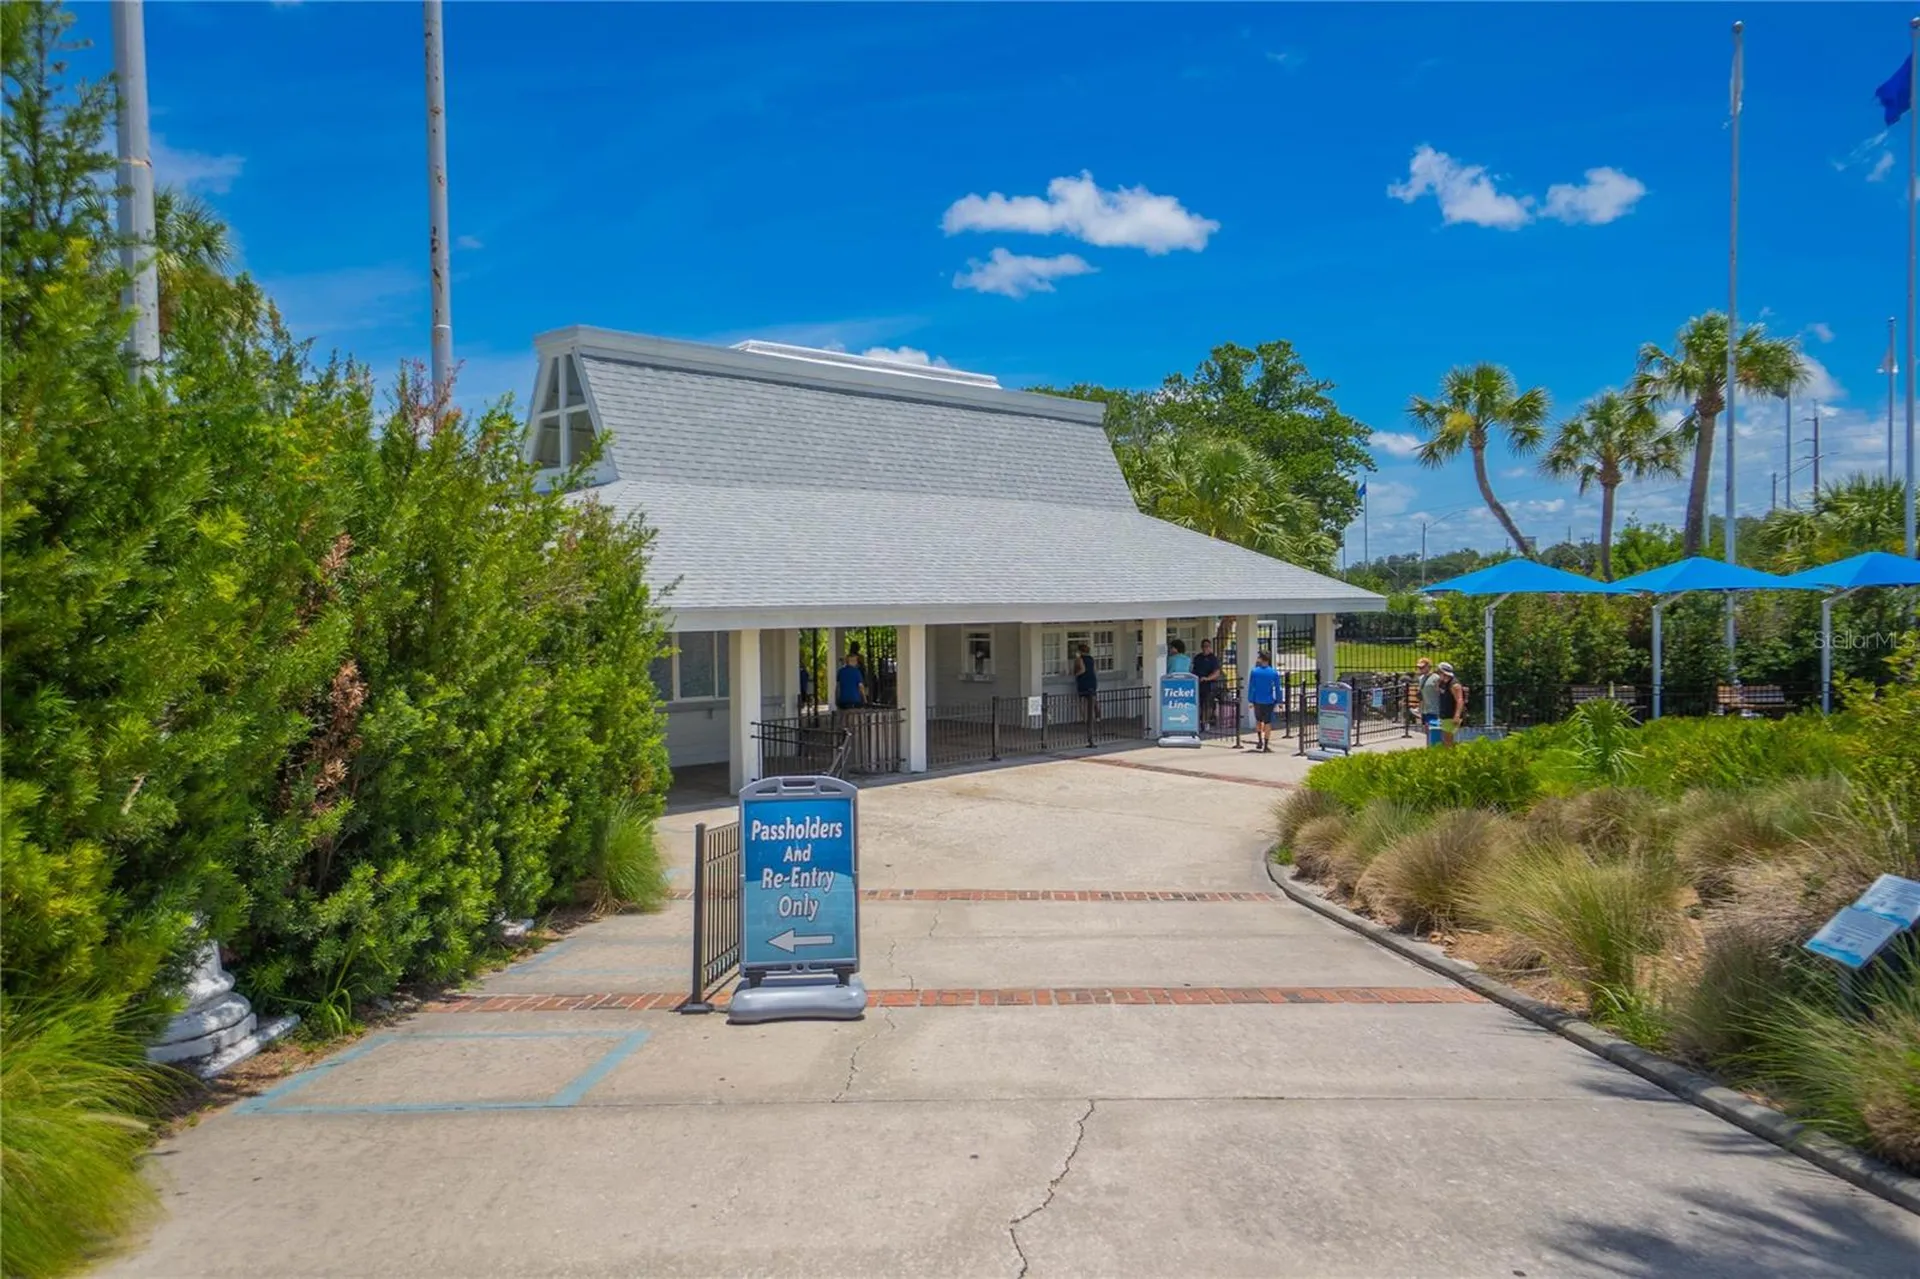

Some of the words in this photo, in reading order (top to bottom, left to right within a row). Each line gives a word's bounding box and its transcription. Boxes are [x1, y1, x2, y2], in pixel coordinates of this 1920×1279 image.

[1163, 687, 1195, 698] Ticket
[1168, 700, 1190, 710] Line
[751, 816, 843, 840] Passholders
[783, 844, 812, 862] And
[762, 867, 835, 892] Re-Entry
[778, 893, 819, 921] Only
